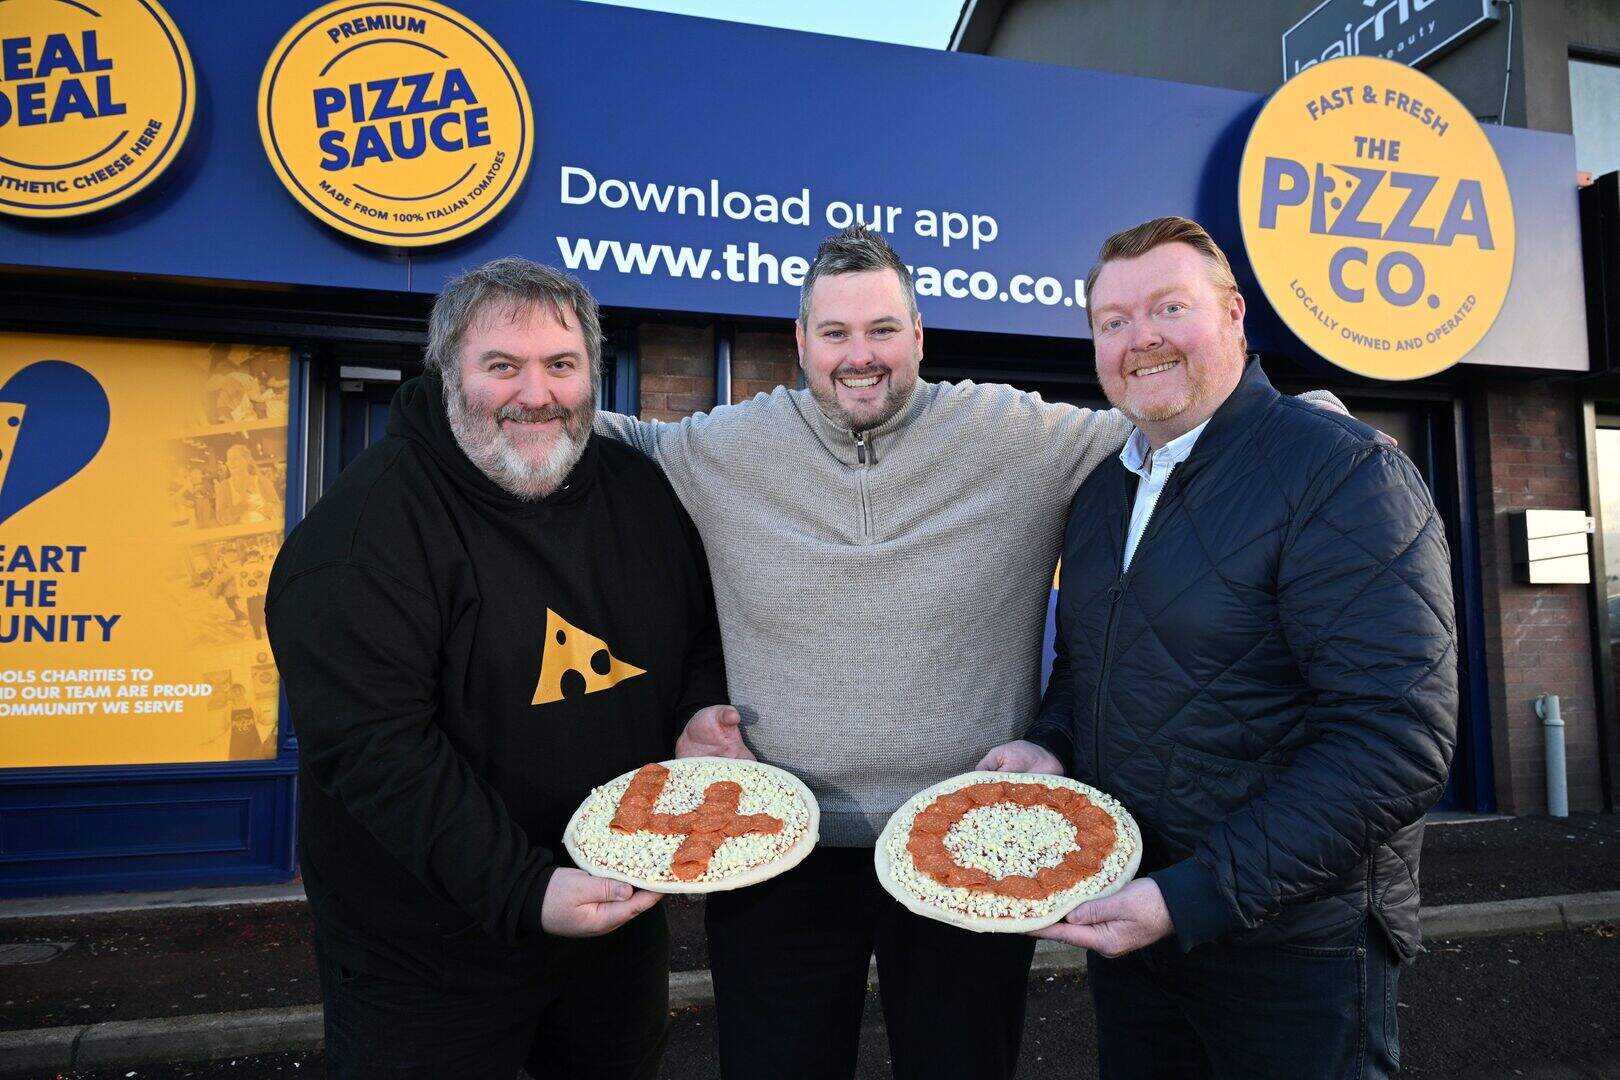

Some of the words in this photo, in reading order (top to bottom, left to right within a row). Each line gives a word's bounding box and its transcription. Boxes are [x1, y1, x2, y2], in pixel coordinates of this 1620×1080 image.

[0, 29, 113, 82] EAL
[327, 15, 426, 44] PREMIUM
[1377, 20, 1435, 58] eauty
[313, 68, 478, 128] PIZZA
[1306, 86, 1355, 121] FAST
[1362, 85, 1378, 105] &
[1385, 89, 1449, 137] FRESH
[0, 175, 69, 193] THETIC
[73, 154, 134, 189] CHEESE
[131, 119, 162, 156] HERE
[319, 107, 491, 172] SAUCE
[1354, 136, 1400, 161] THE
[319, 179, 352, 206] MADE
[353, 203, 388, 221] FROM
[393, 213, 423, 222] 100%
[426, 199, 469, 220] ITALIAN
[468, 150, 506, 201] TOMATOES
[560, 166, 810, 226] Download
[826, 200, 902, 233] our
[914, 207, 999, 250] app
[1258, 156, 1495, 250] PIZZA
[1328, 246, 1440, 309] CO.
[1290, 279, 1338, 331] LOCALLY
[1341, 327, 1391, 351] OWNED
[1396, 338, 1423, 351] AND
[1426, 294, 1476, 343] OPERATED
[0, 580, 57, 608] HE
[0, 670, 36, 683] OLS
[41, 669, 126, 682] CHARITIES
[130, 669, 154, 681] TO
[21, 686, 60, 699] OUR
[64, 685, 111, 698] TEAM
[116, 684, 149, 697] ARE
[153, 683, 213, 697] PROUD
[0, 702, 98, 717] OMMUNITY
[102, 701, 130, 714] WE
[134, 700, 183, 713] SERVE
